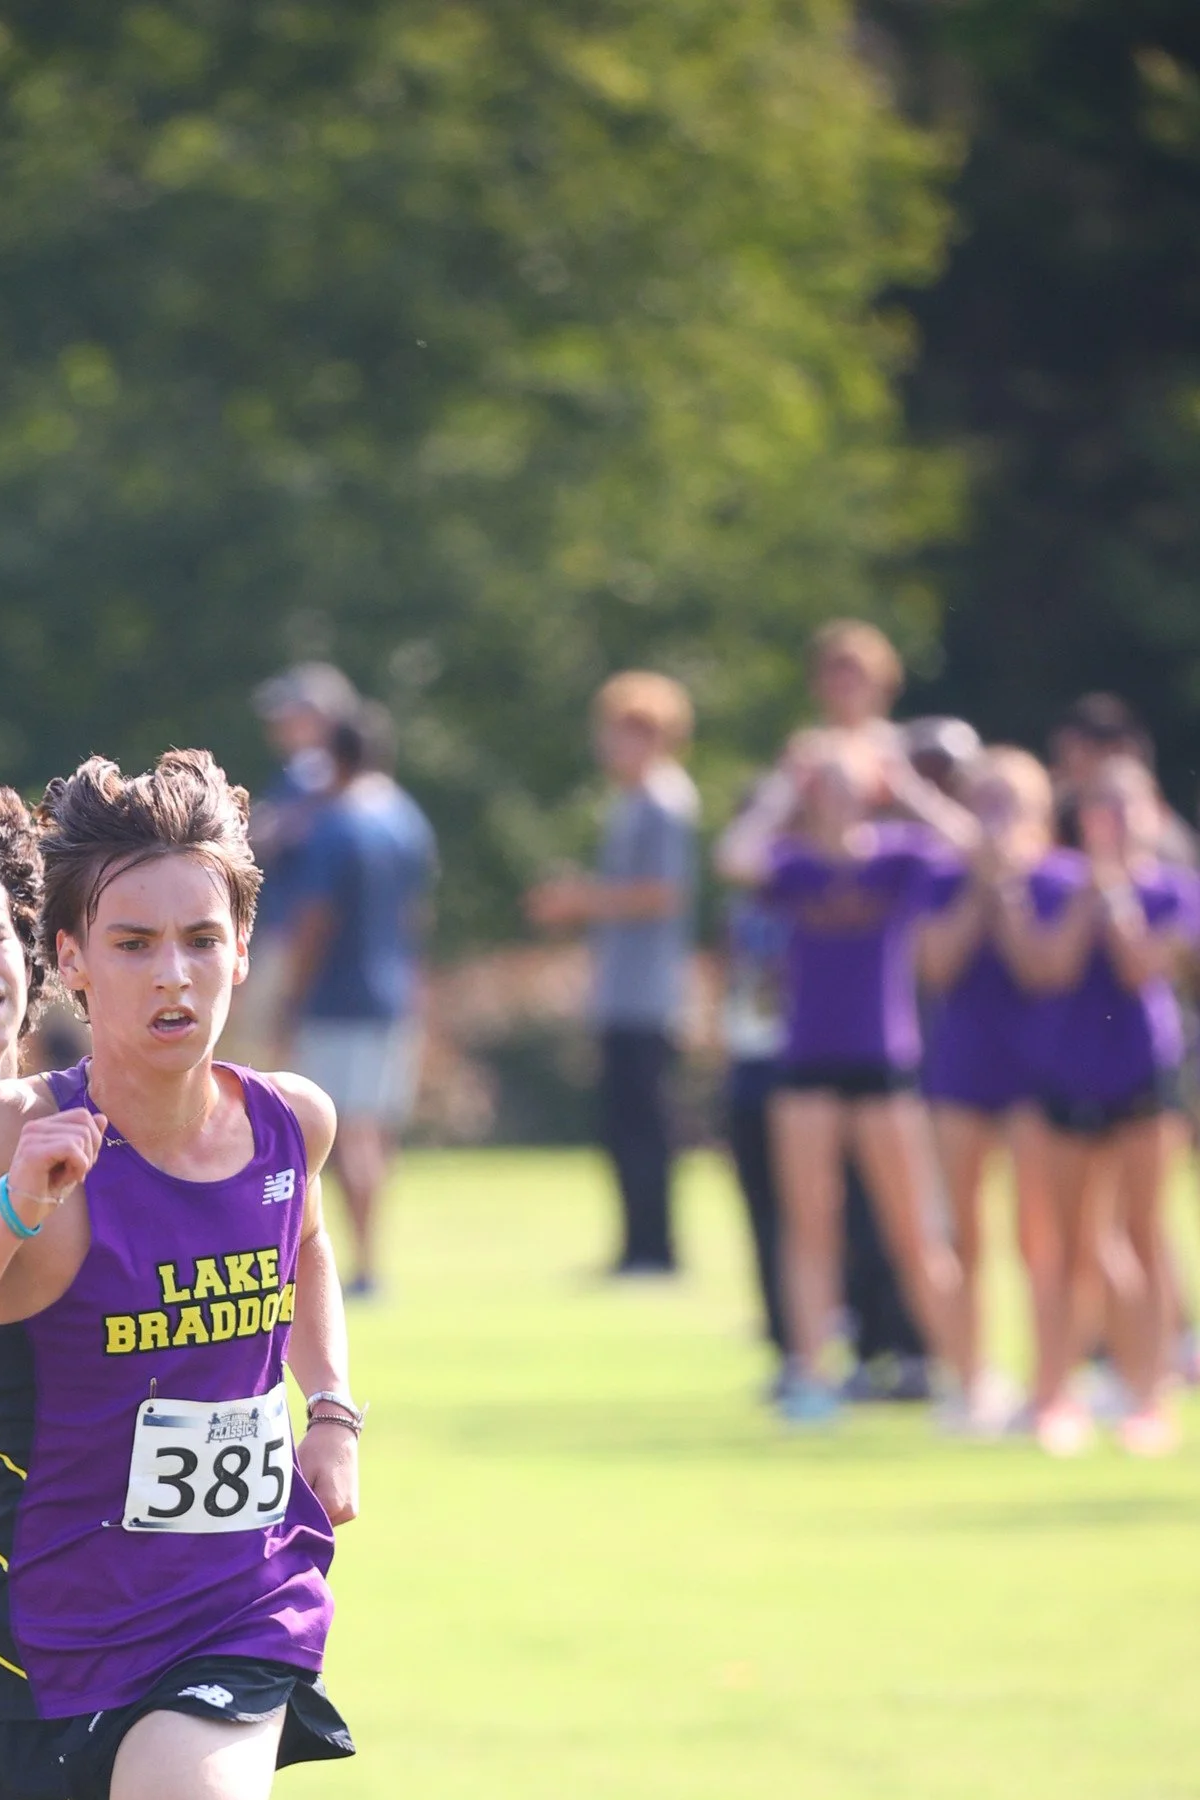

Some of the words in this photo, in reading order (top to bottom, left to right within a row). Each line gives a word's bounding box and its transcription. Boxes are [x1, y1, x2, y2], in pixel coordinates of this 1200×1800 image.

[158, 1248, 280, 1304] LAKE
[104, 1282, 297, 1355] BRADDOK
[212, 1424, 253, 1440] CLASSIC
[147, 1436, 285, 1518] 385
